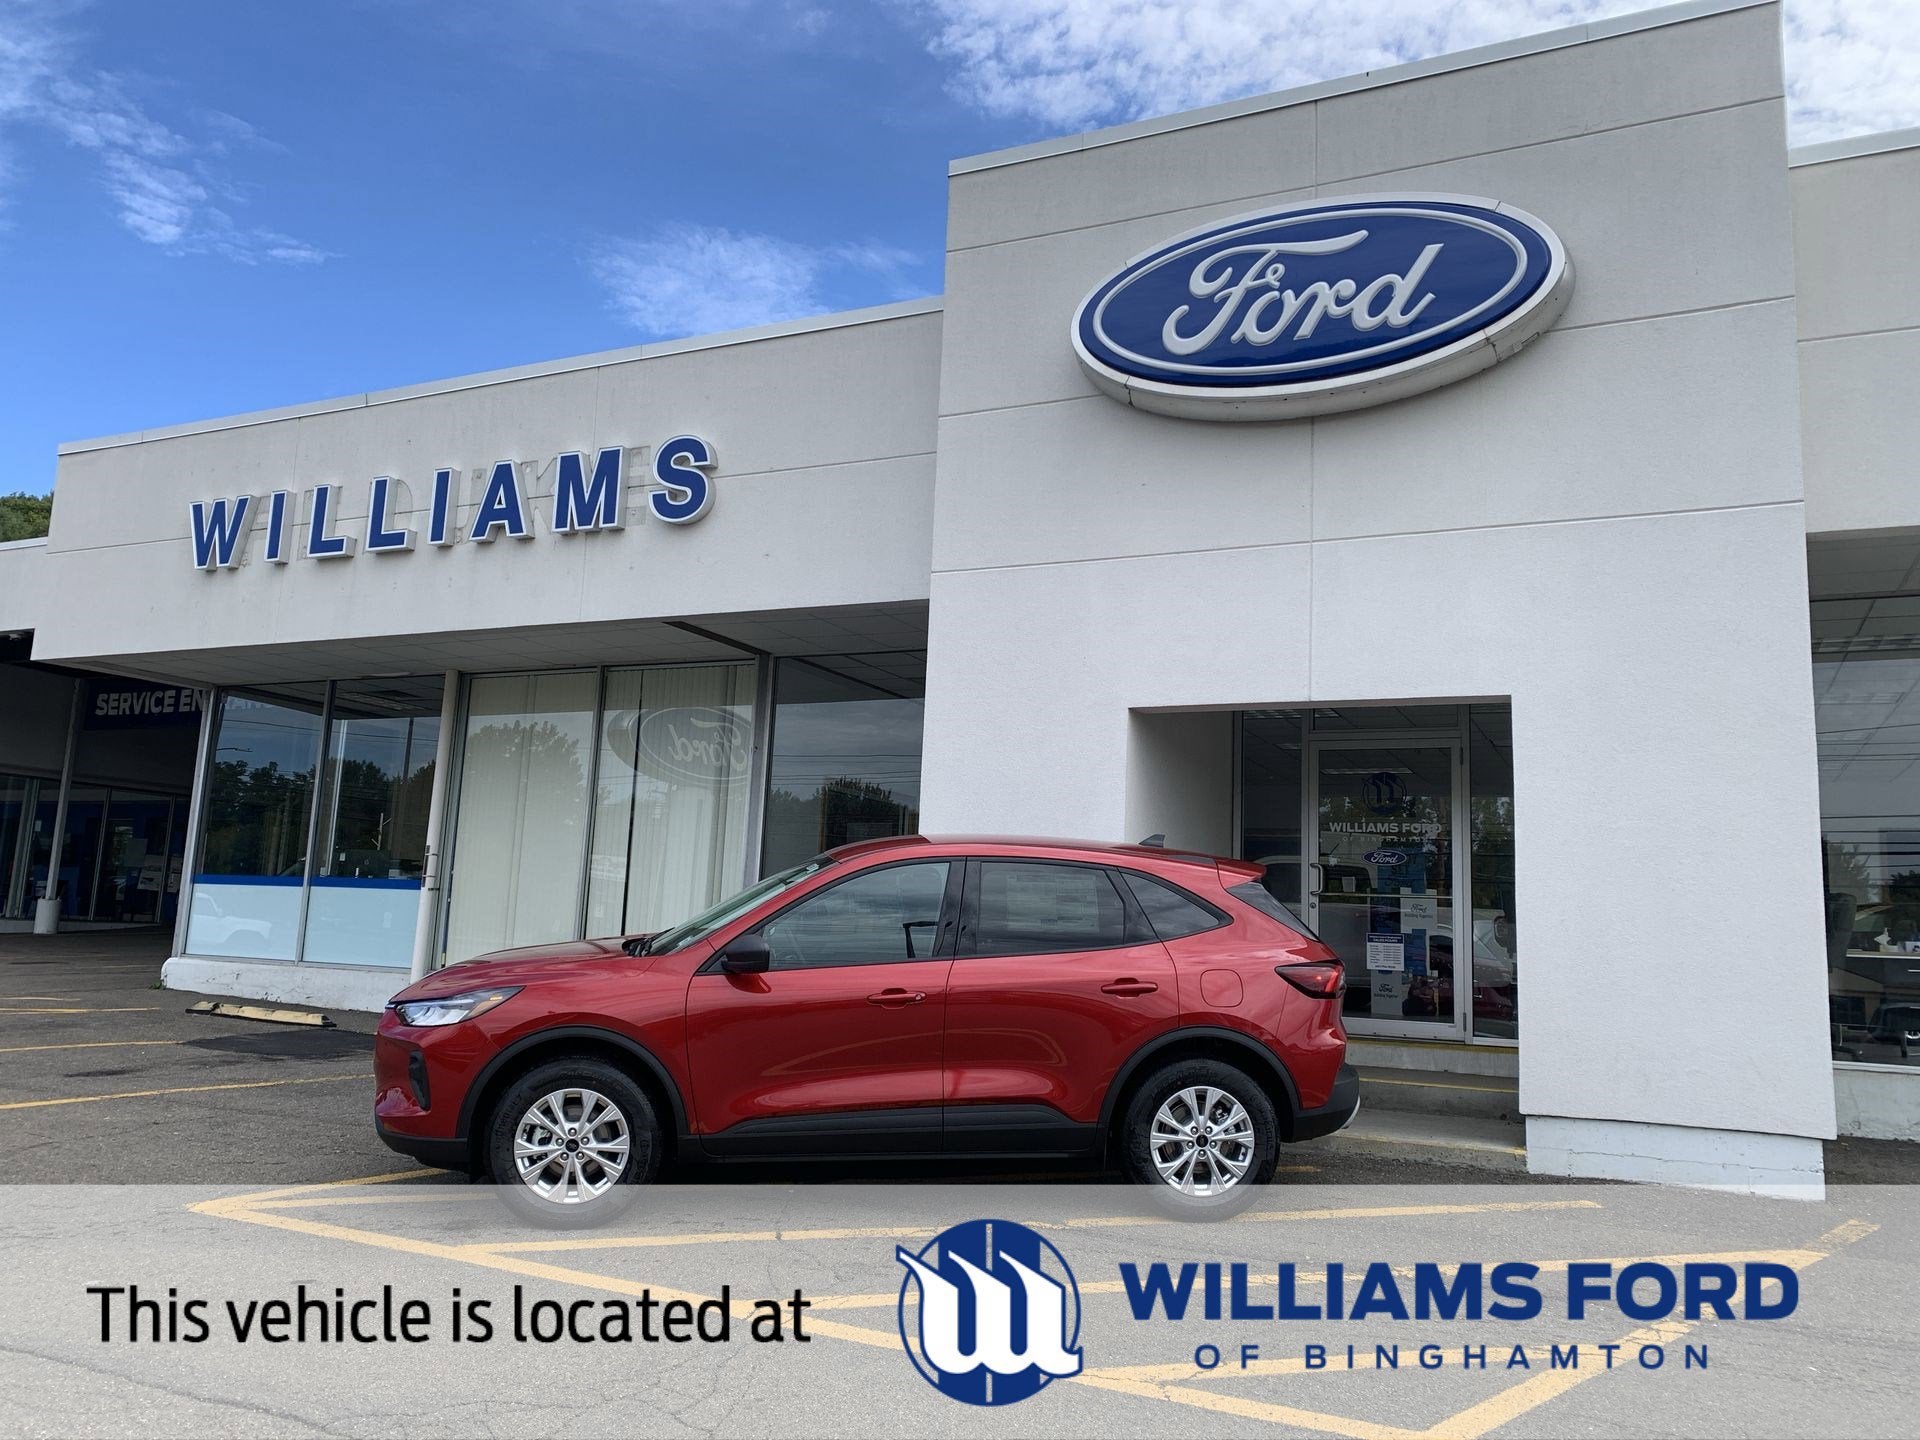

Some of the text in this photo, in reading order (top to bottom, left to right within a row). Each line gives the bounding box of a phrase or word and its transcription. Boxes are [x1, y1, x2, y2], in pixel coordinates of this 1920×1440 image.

[1162, 229, 1444, 356] Ford
[190, 434, 718, 571] WILLIAMS
[95, 689, 176, 716] SERVICE
[1329, 822, 1399, 833] WILLIAMS
[1370, 852, 1399, 864] Ford
